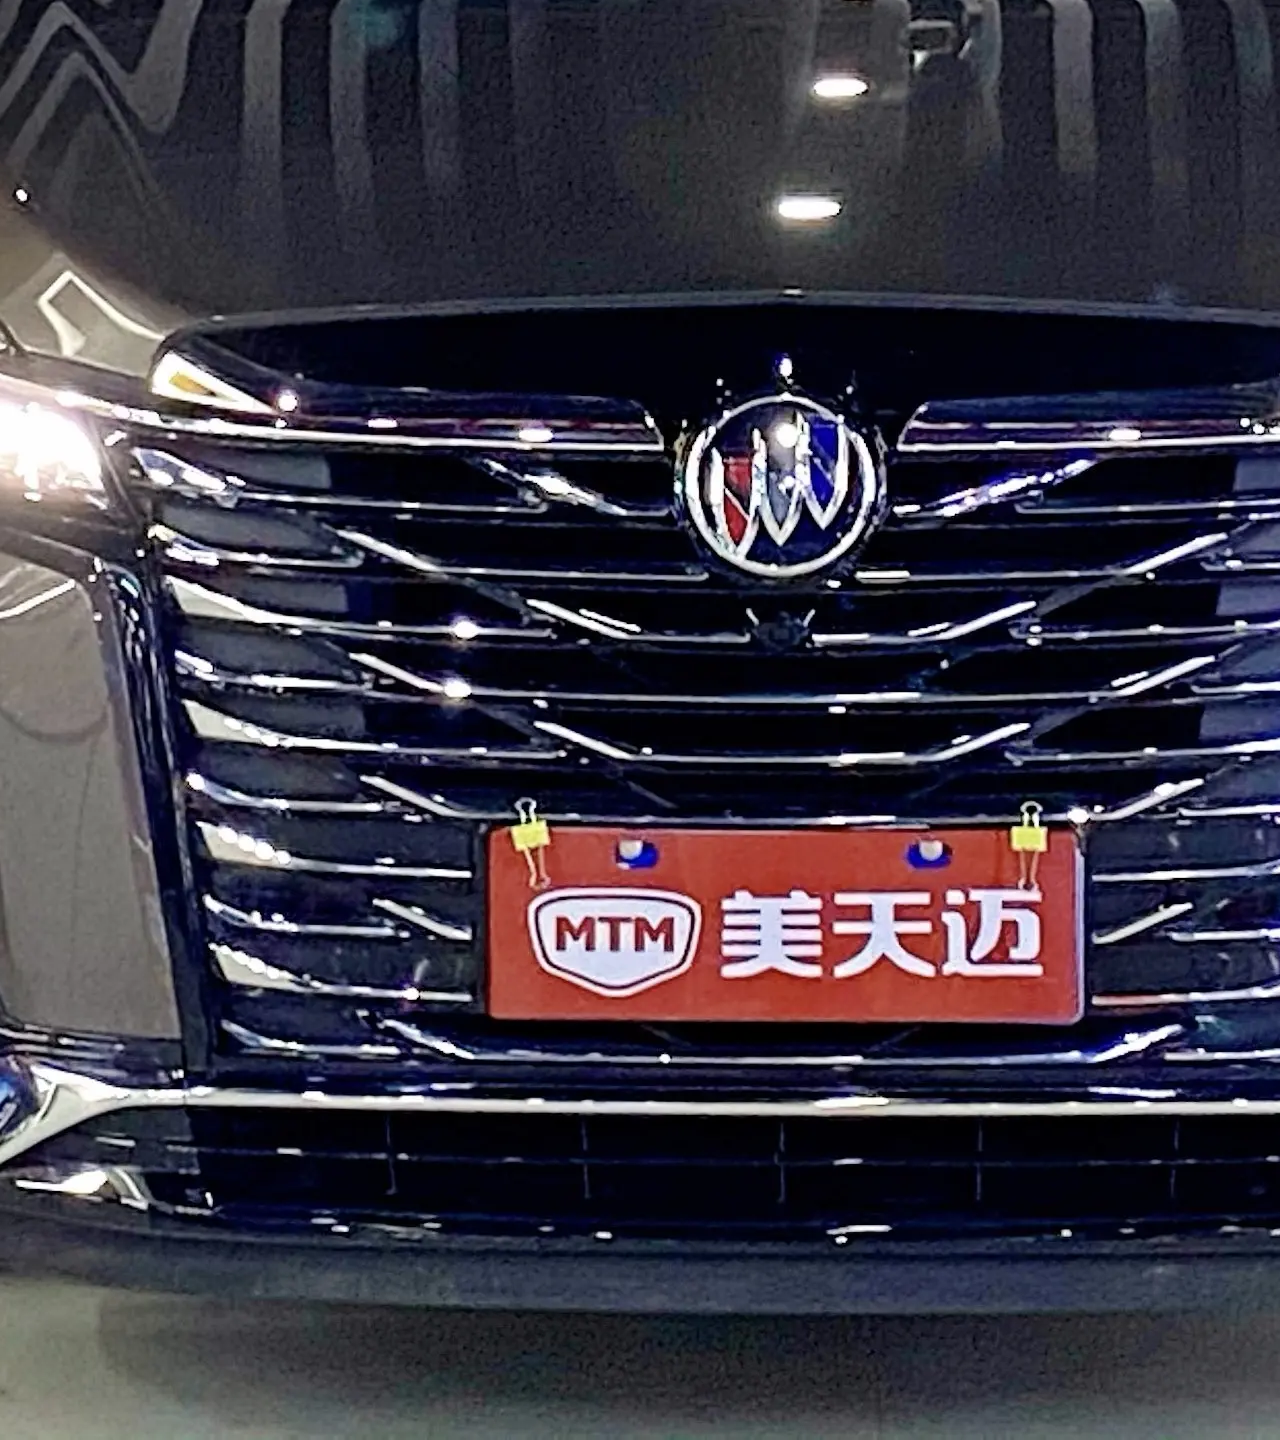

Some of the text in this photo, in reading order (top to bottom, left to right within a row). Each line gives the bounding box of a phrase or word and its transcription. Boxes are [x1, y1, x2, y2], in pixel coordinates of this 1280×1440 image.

[556, 889, 1044, 980] MTM 美天迈
